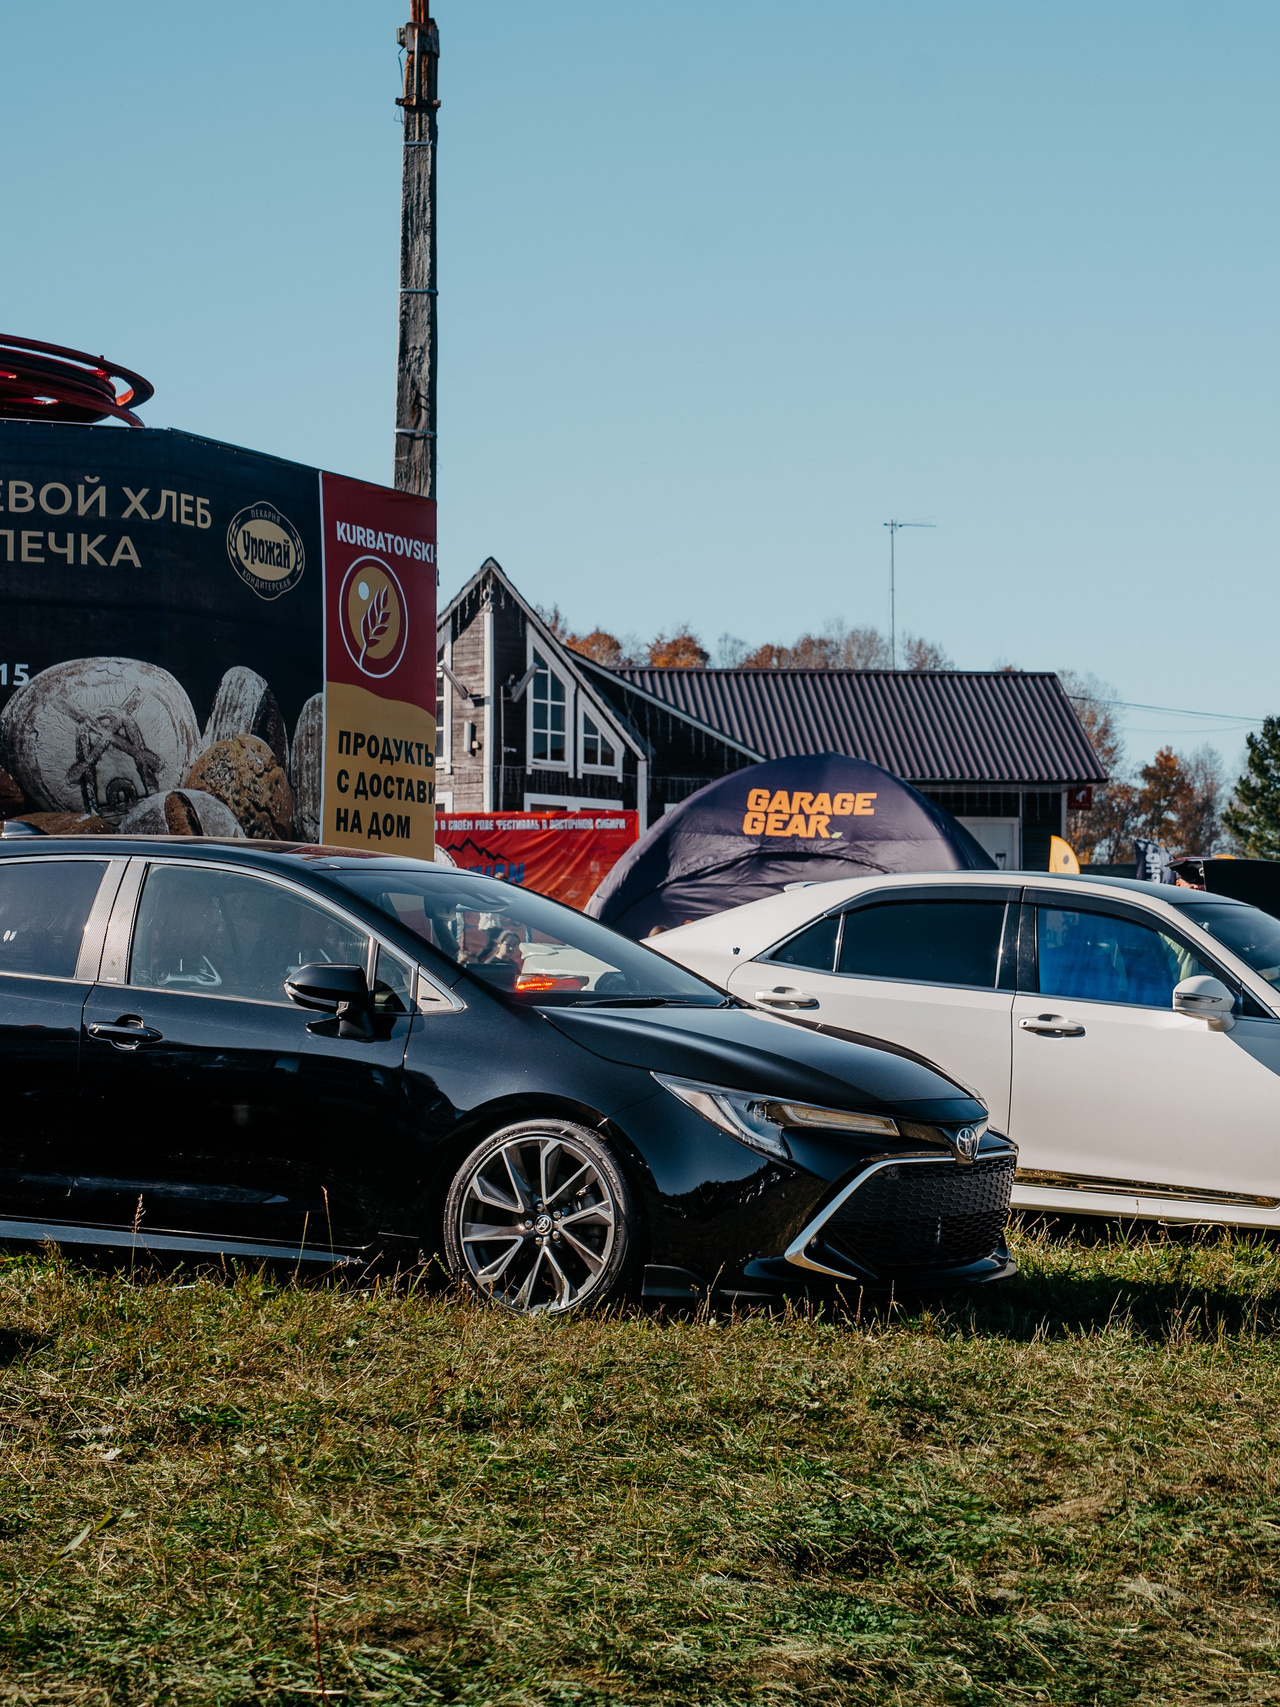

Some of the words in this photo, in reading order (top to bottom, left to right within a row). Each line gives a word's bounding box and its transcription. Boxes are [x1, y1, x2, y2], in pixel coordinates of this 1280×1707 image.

[0, 475, 107, 517] ВОЙ
[121, 486, 212, 529] ХЛЕБ
[250, 509, 281, 524] ПЕКАРНЯ
[242, 529, 291, 570] Урожай
[241, 568, 292, 592] КОНДИТЕРСКАЯ
[336, 769, 350, 793] С
[746, 788, 878, 816] GARAGE
[335, 807, 363, 834] НА
[367, 811, 411, 841] ДОМ
